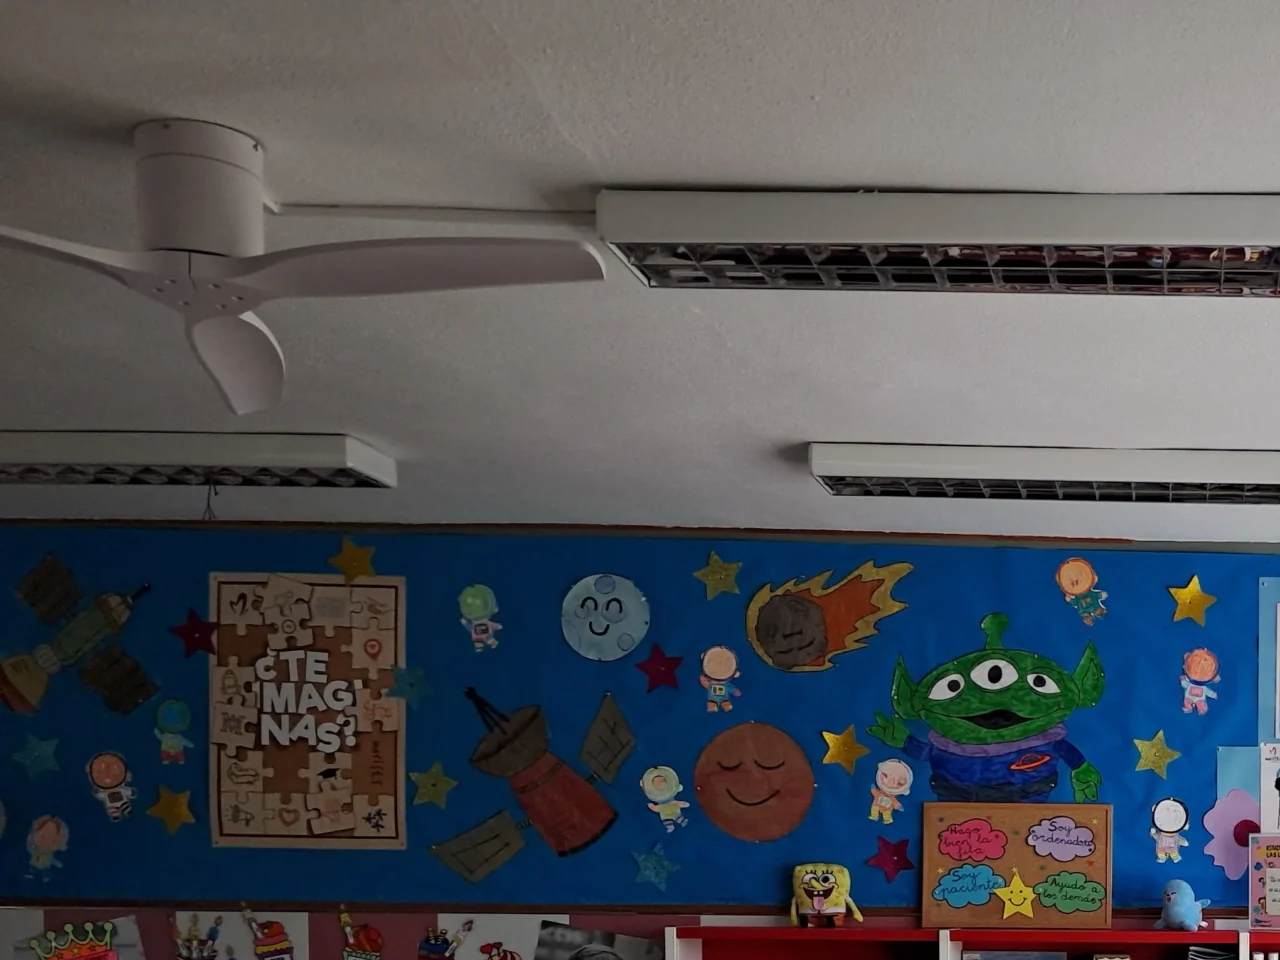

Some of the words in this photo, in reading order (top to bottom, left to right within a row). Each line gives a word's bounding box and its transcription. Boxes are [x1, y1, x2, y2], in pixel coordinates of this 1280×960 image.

[260, 712, 357, 754] NAS?
[950, 827, 982, 839] Hago
[1048, 821, 1073, 837] Soy
[943, 837, 970, 847] buen
[976, 833, 992, 844] la
[957, 845, 984, 859] fila
[951, 870, 980, 885] Soy
[941, 878, 1002, 899] paciente
[1049, 877, 1087, 893] Ayudo
[1091, 886, 1101, 894] a
[1042, 888, 1057, 900] los
